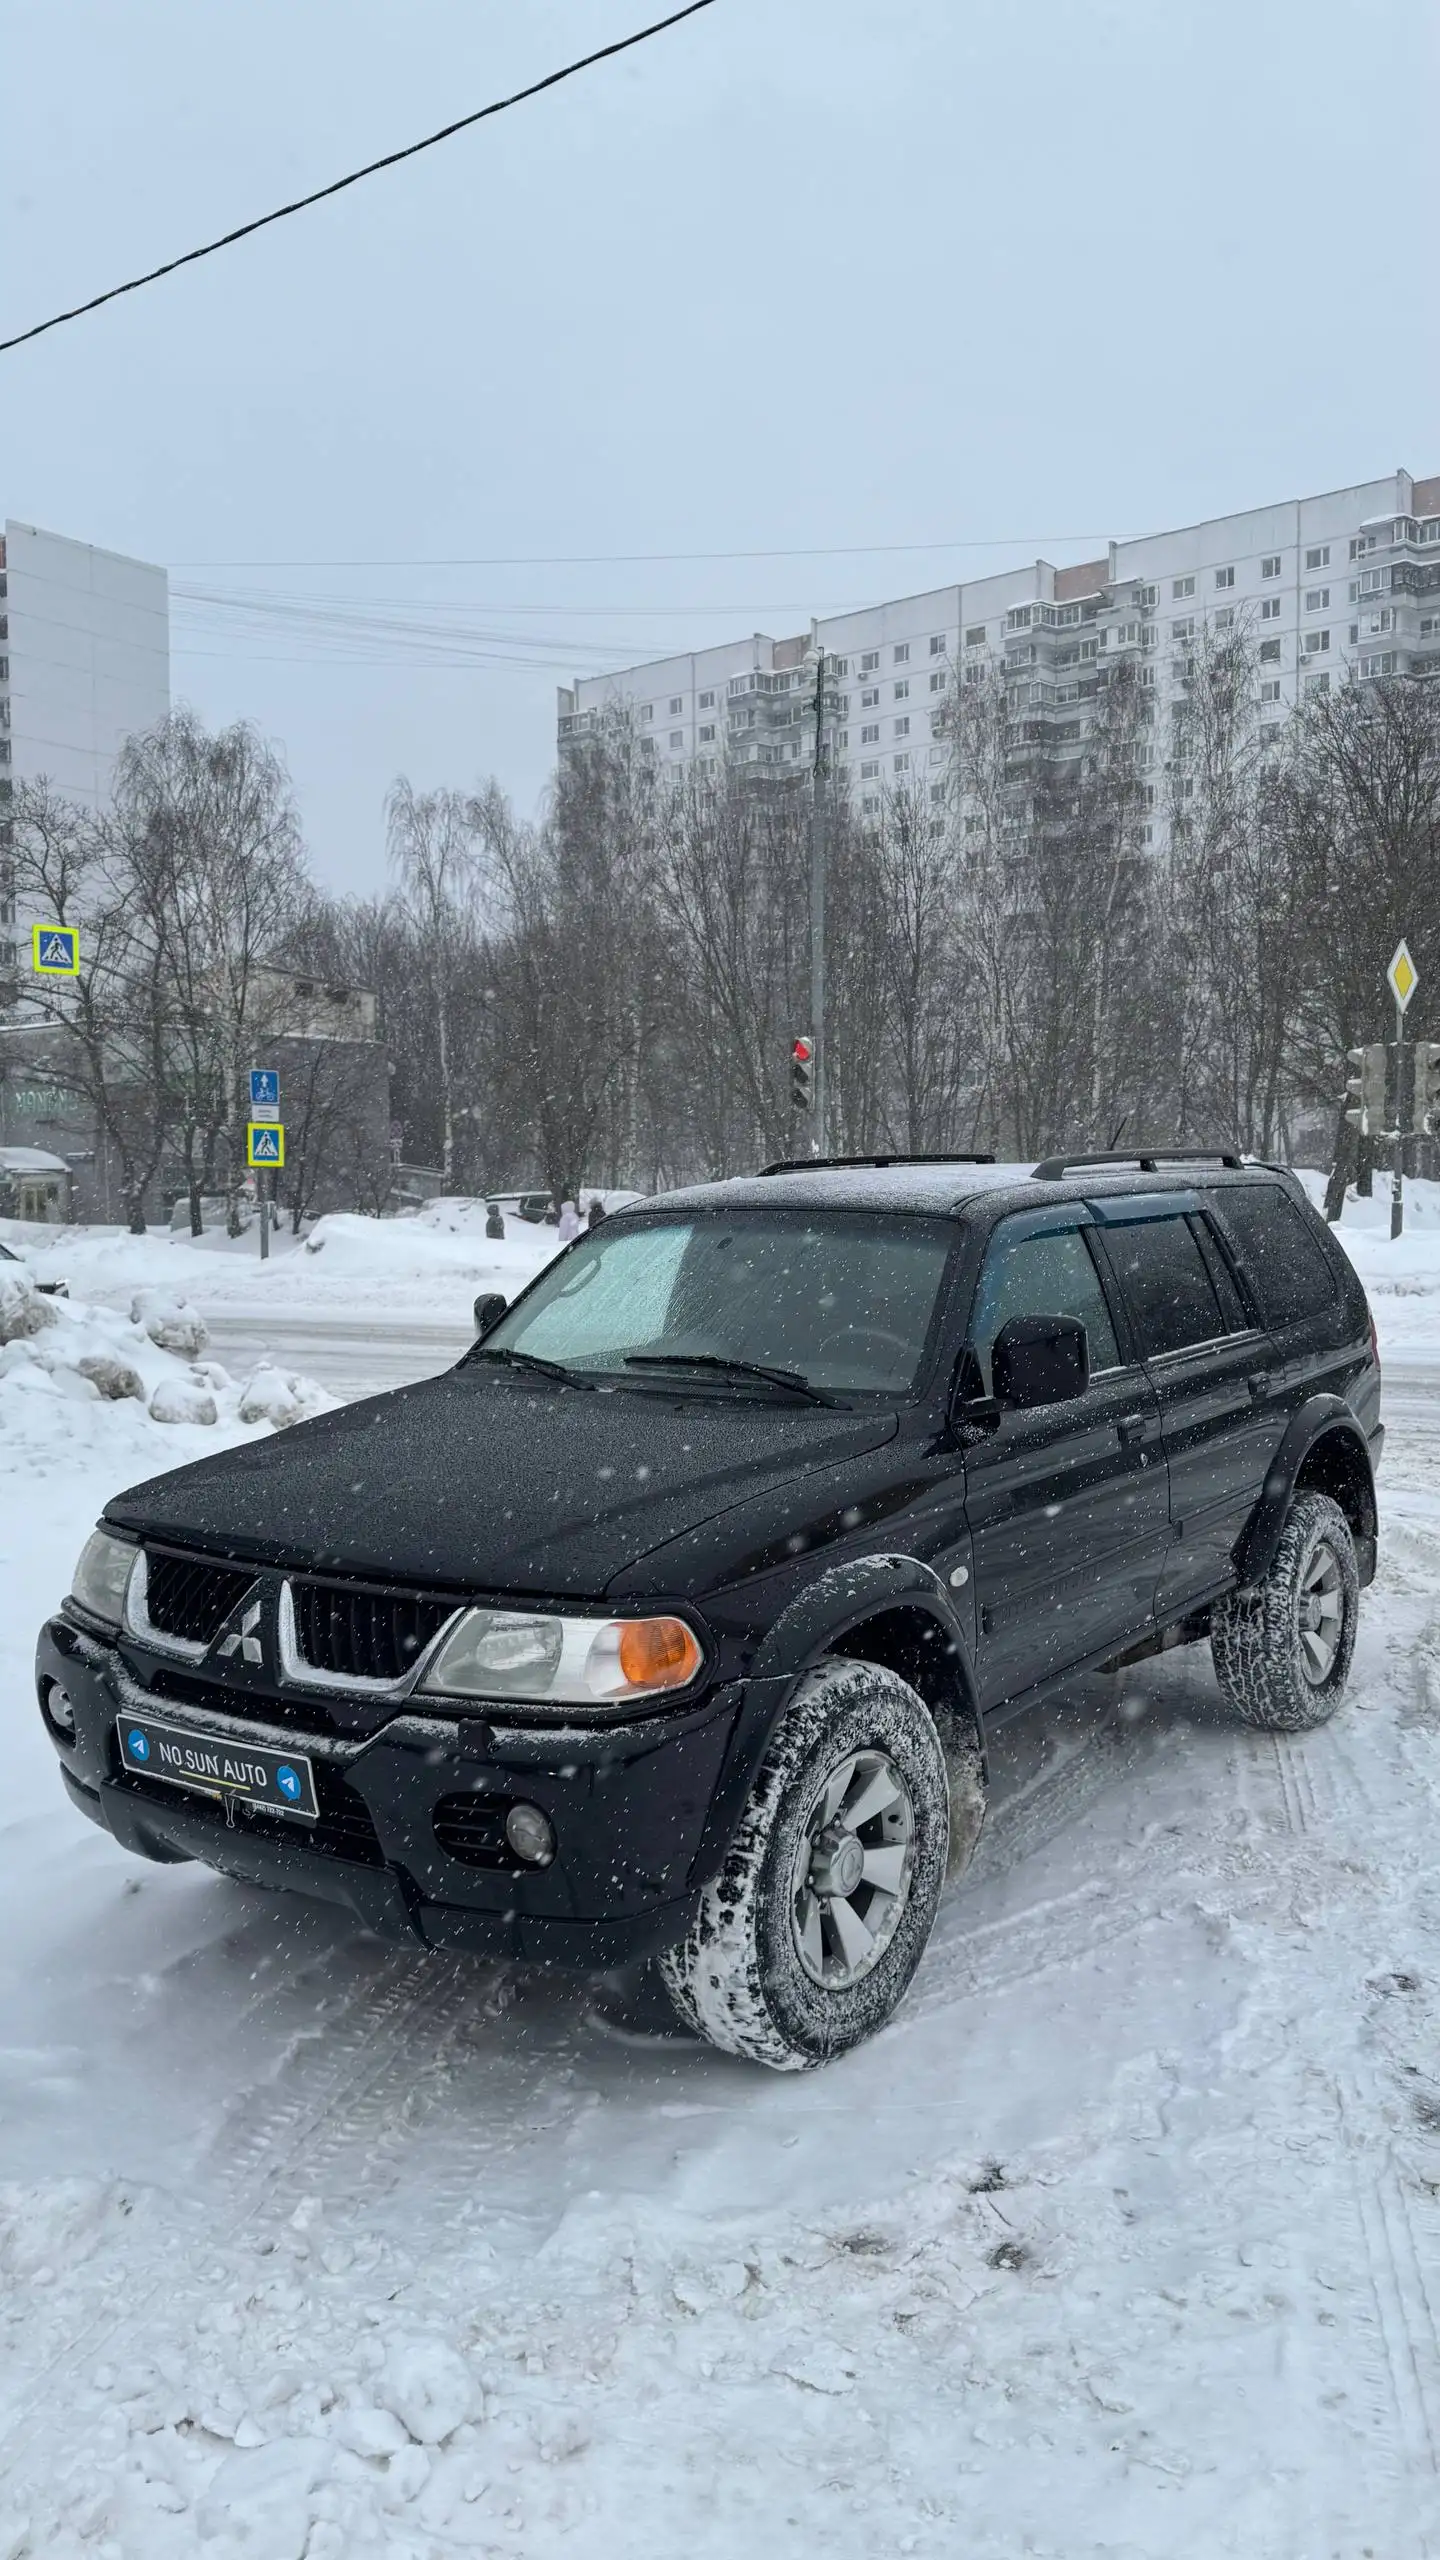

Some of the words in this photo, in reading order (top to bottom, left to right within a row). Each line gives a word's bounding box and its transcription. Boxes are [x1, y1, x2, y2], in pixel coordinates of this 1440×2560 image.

[159, 1742, 182, 1766] NO
[185, 1749, 219, 1776] SUN
[224, 1759, 267, 1787] AUTO
